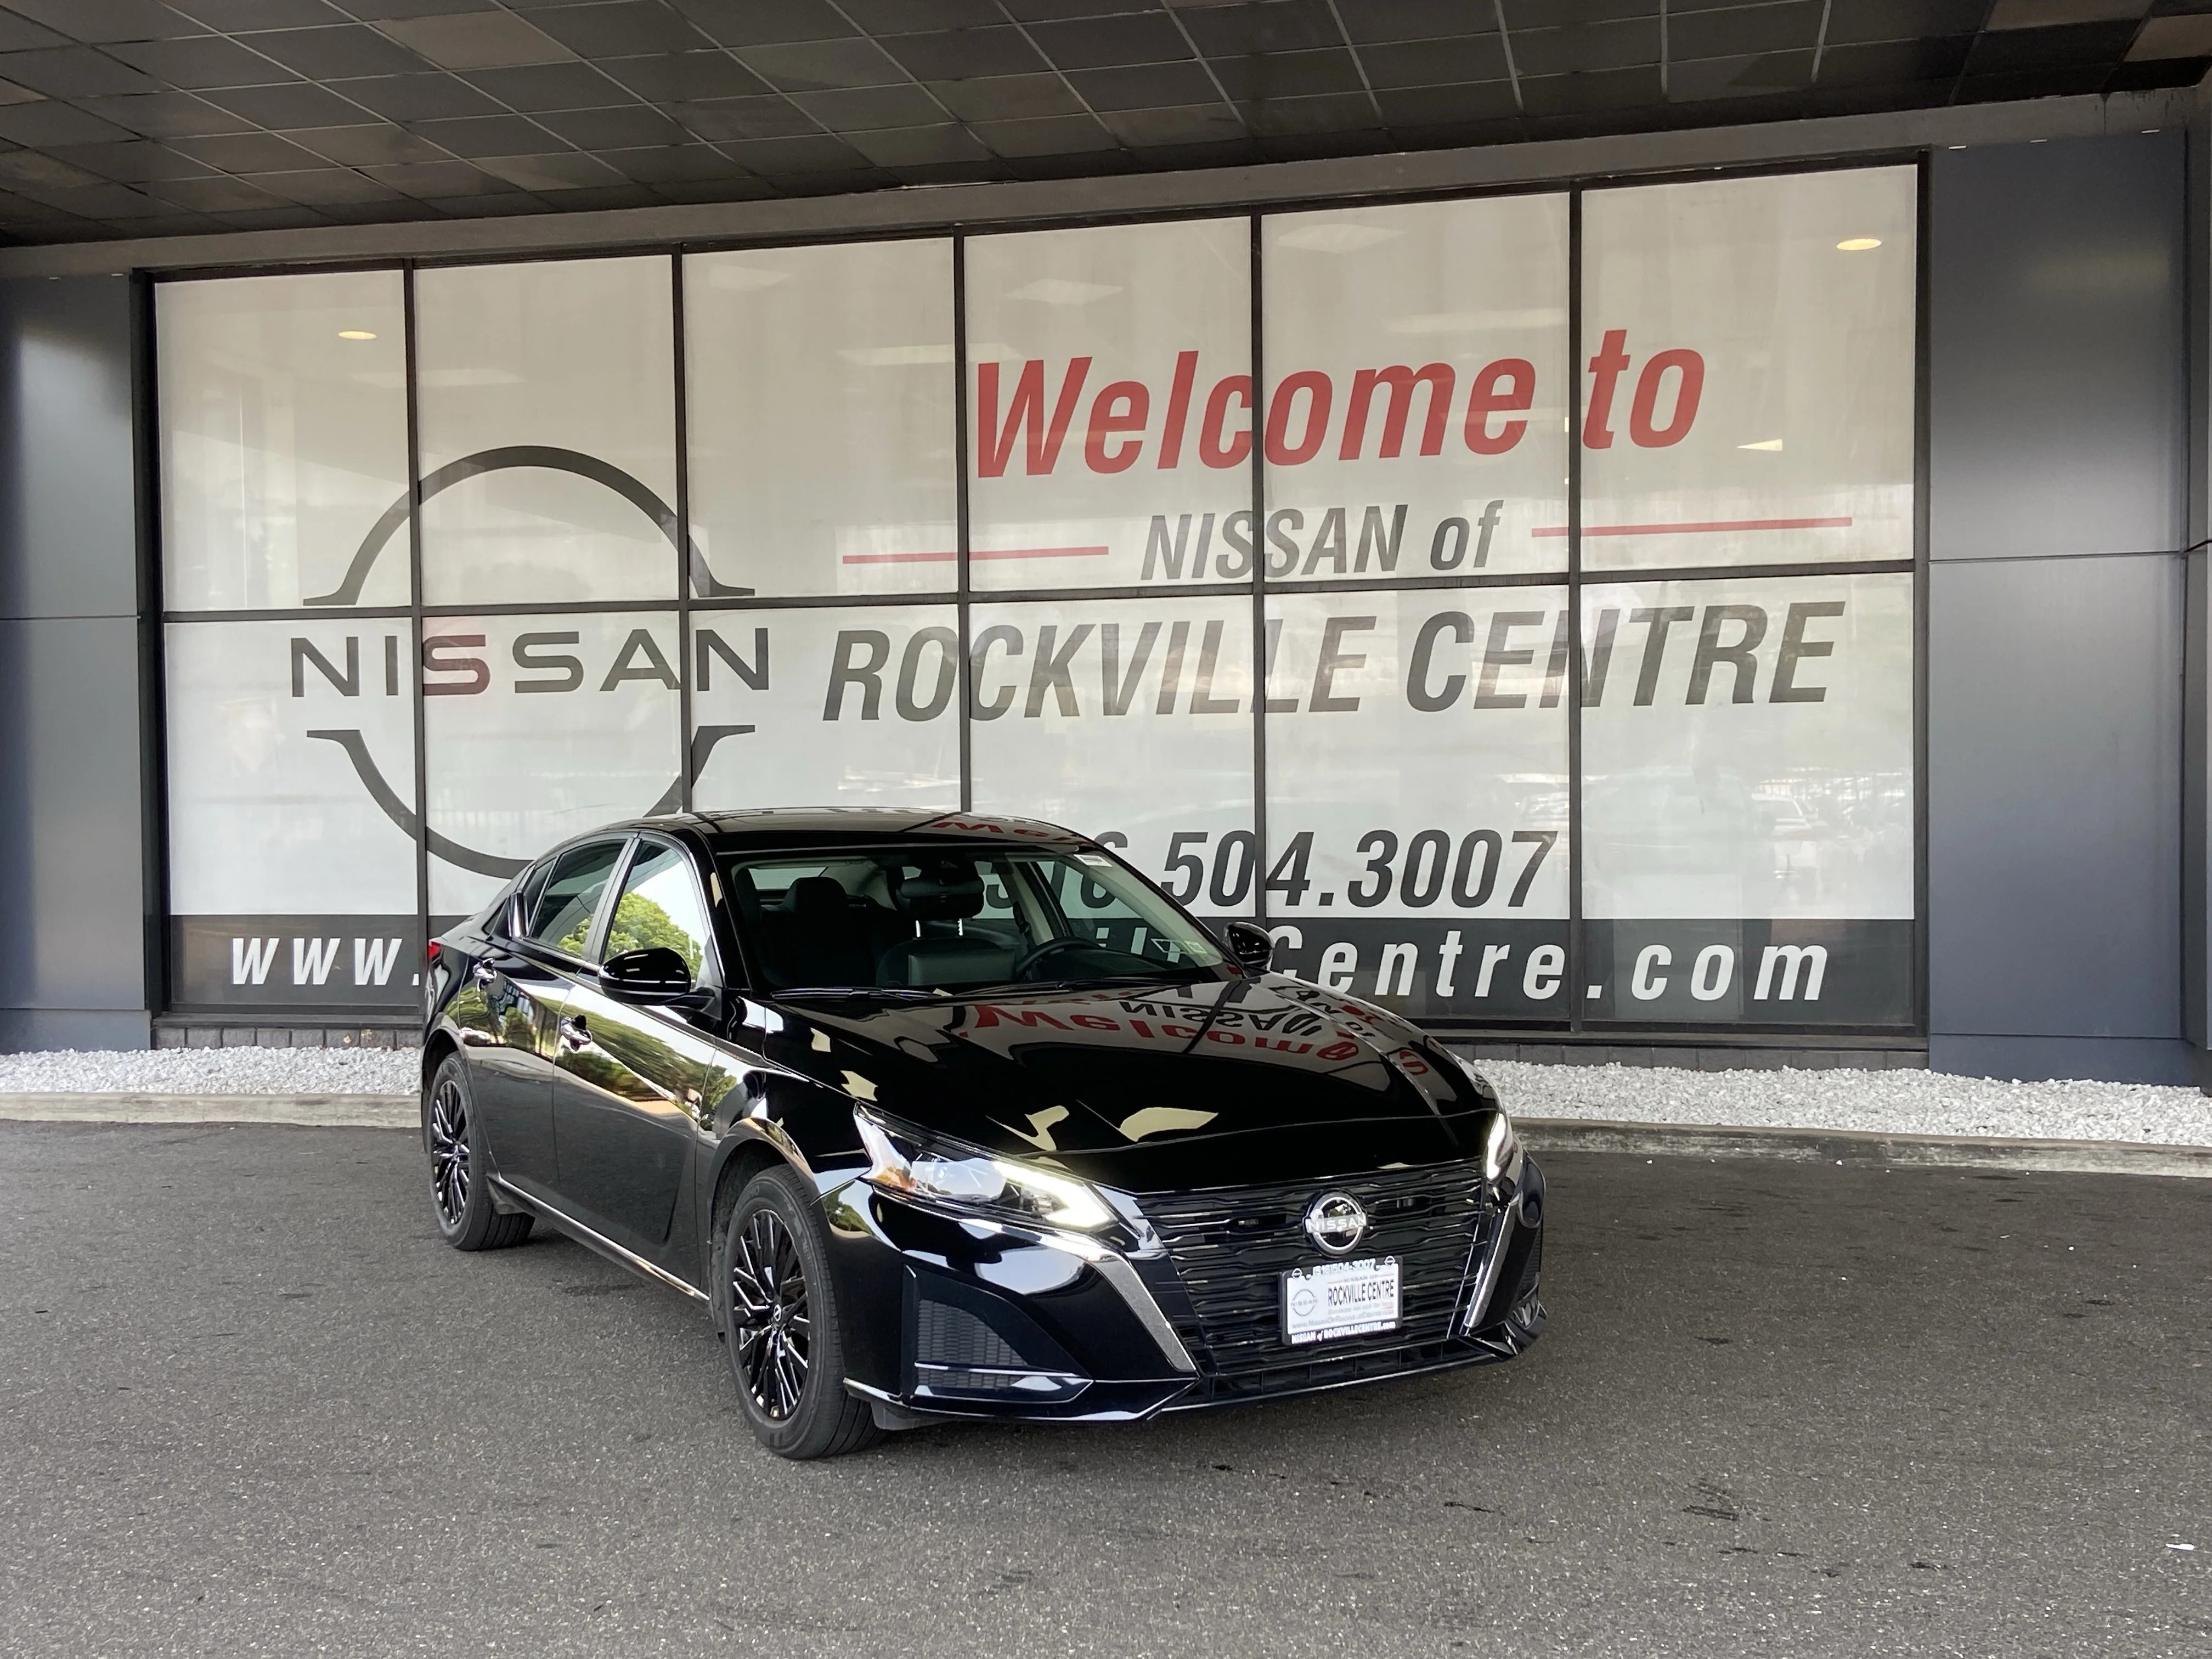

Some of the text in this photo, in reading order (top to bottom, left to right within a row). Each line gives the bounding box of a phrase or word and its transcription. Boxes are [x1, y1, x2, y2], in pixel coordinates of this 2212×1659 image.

[978, 329, 1705, 478] Welcome to
[1141, 500, 1504, 580] NISSAN of
[291, 628, 769, 697] NISSAN
[822, 601, 1846, 721] ROCKVILLE CENTRE
[1307, 1215, 1367, 1232] NISSAN
[1290, 1298, 1318, 1307] NISSAN
[1328, 1283, 1366, 1307] ROCKVILLE
[1367, 1279, 1395, 1301] CENTRE
[1291, 1331, 1317, 1345] NISSAN
